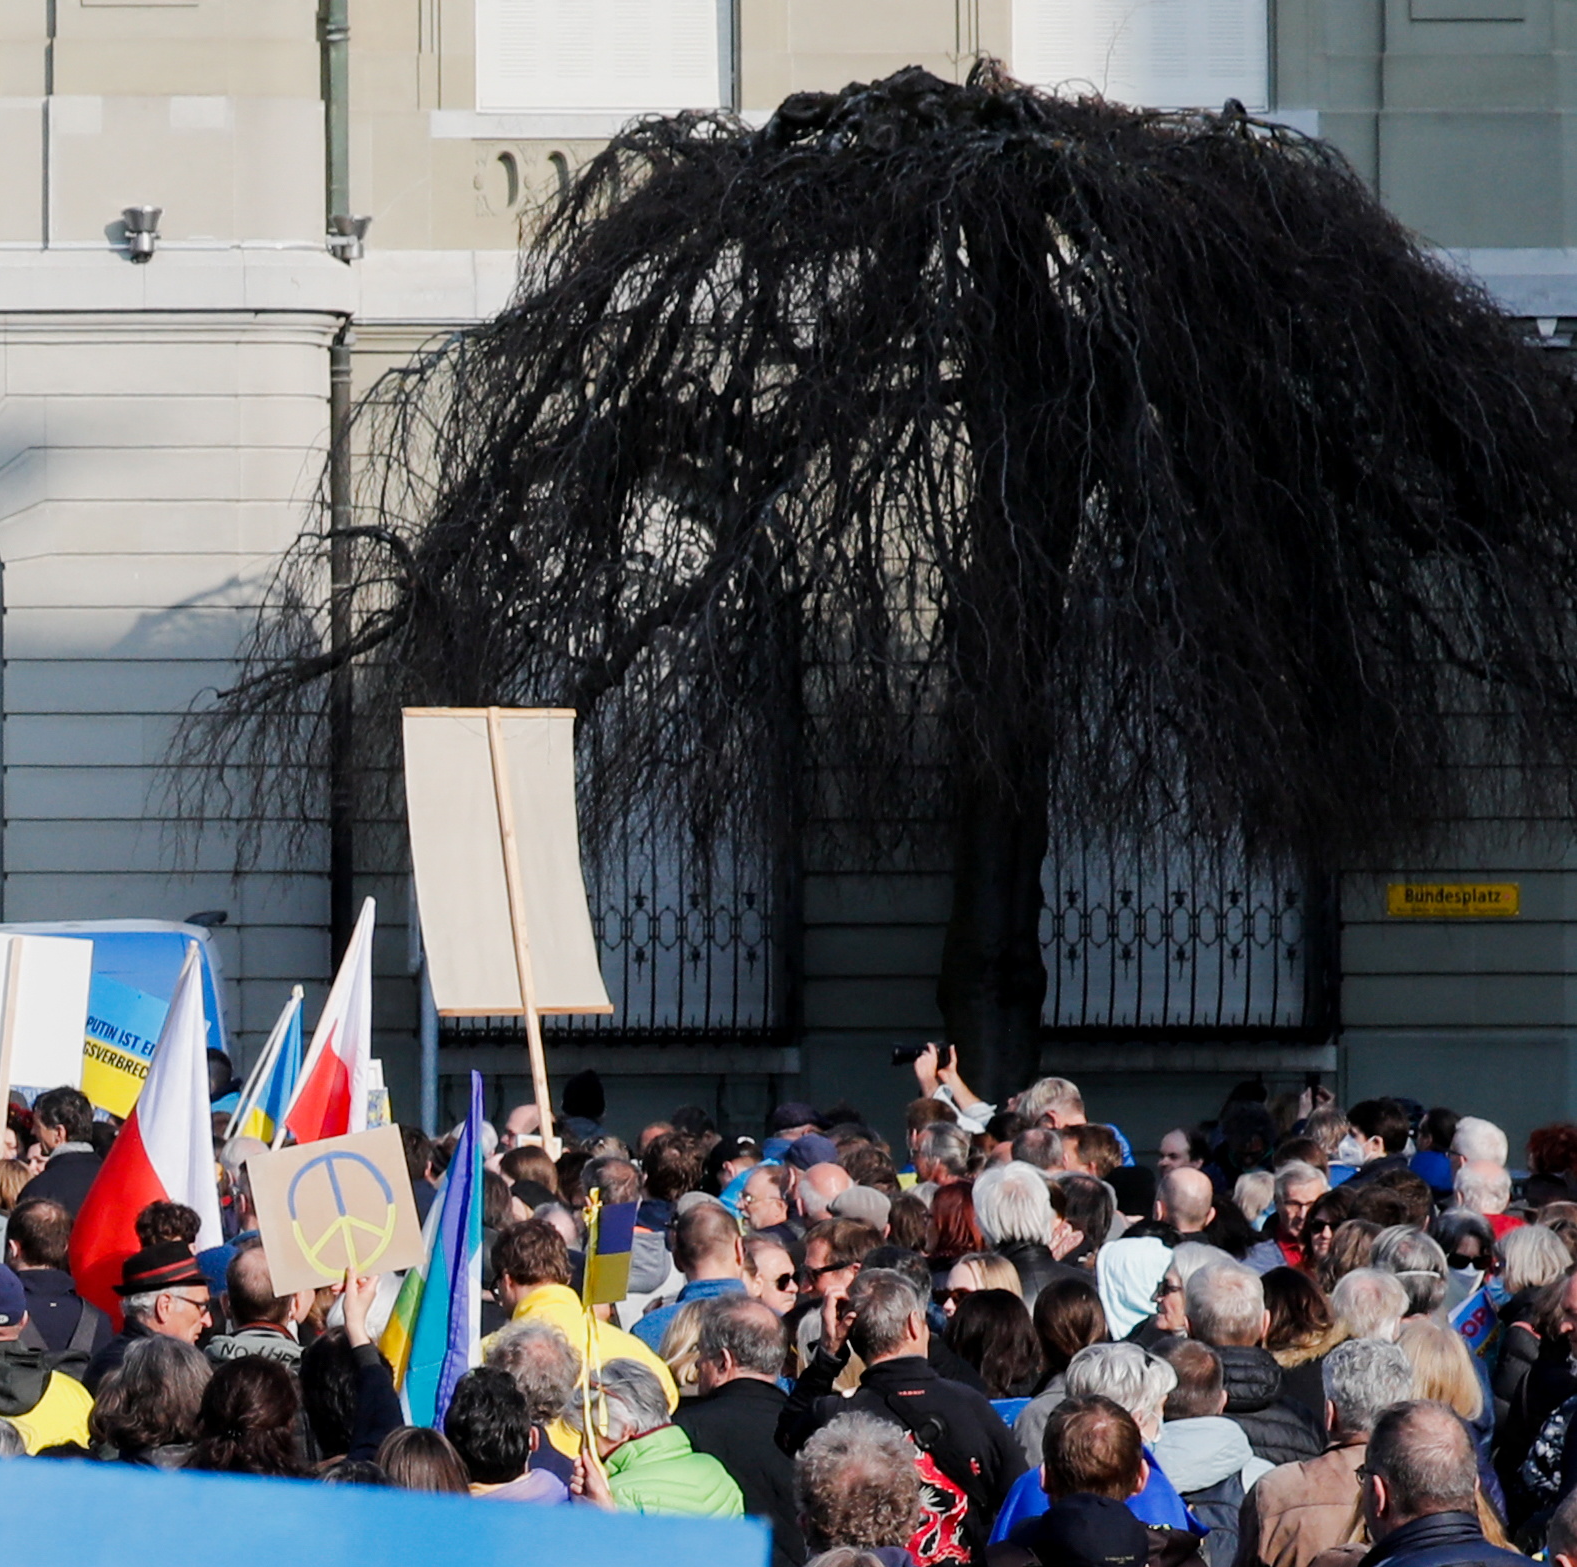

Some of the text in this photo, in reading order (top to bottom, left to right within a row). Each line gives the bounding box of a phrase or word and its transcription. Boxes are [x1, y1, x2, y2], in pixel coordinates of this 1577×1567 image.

[1405, 888, 1501, 906] Bundesplatz
[86, 1015, 119, 1041] PUTIN
[117, 1029, 141, 1051] IST
